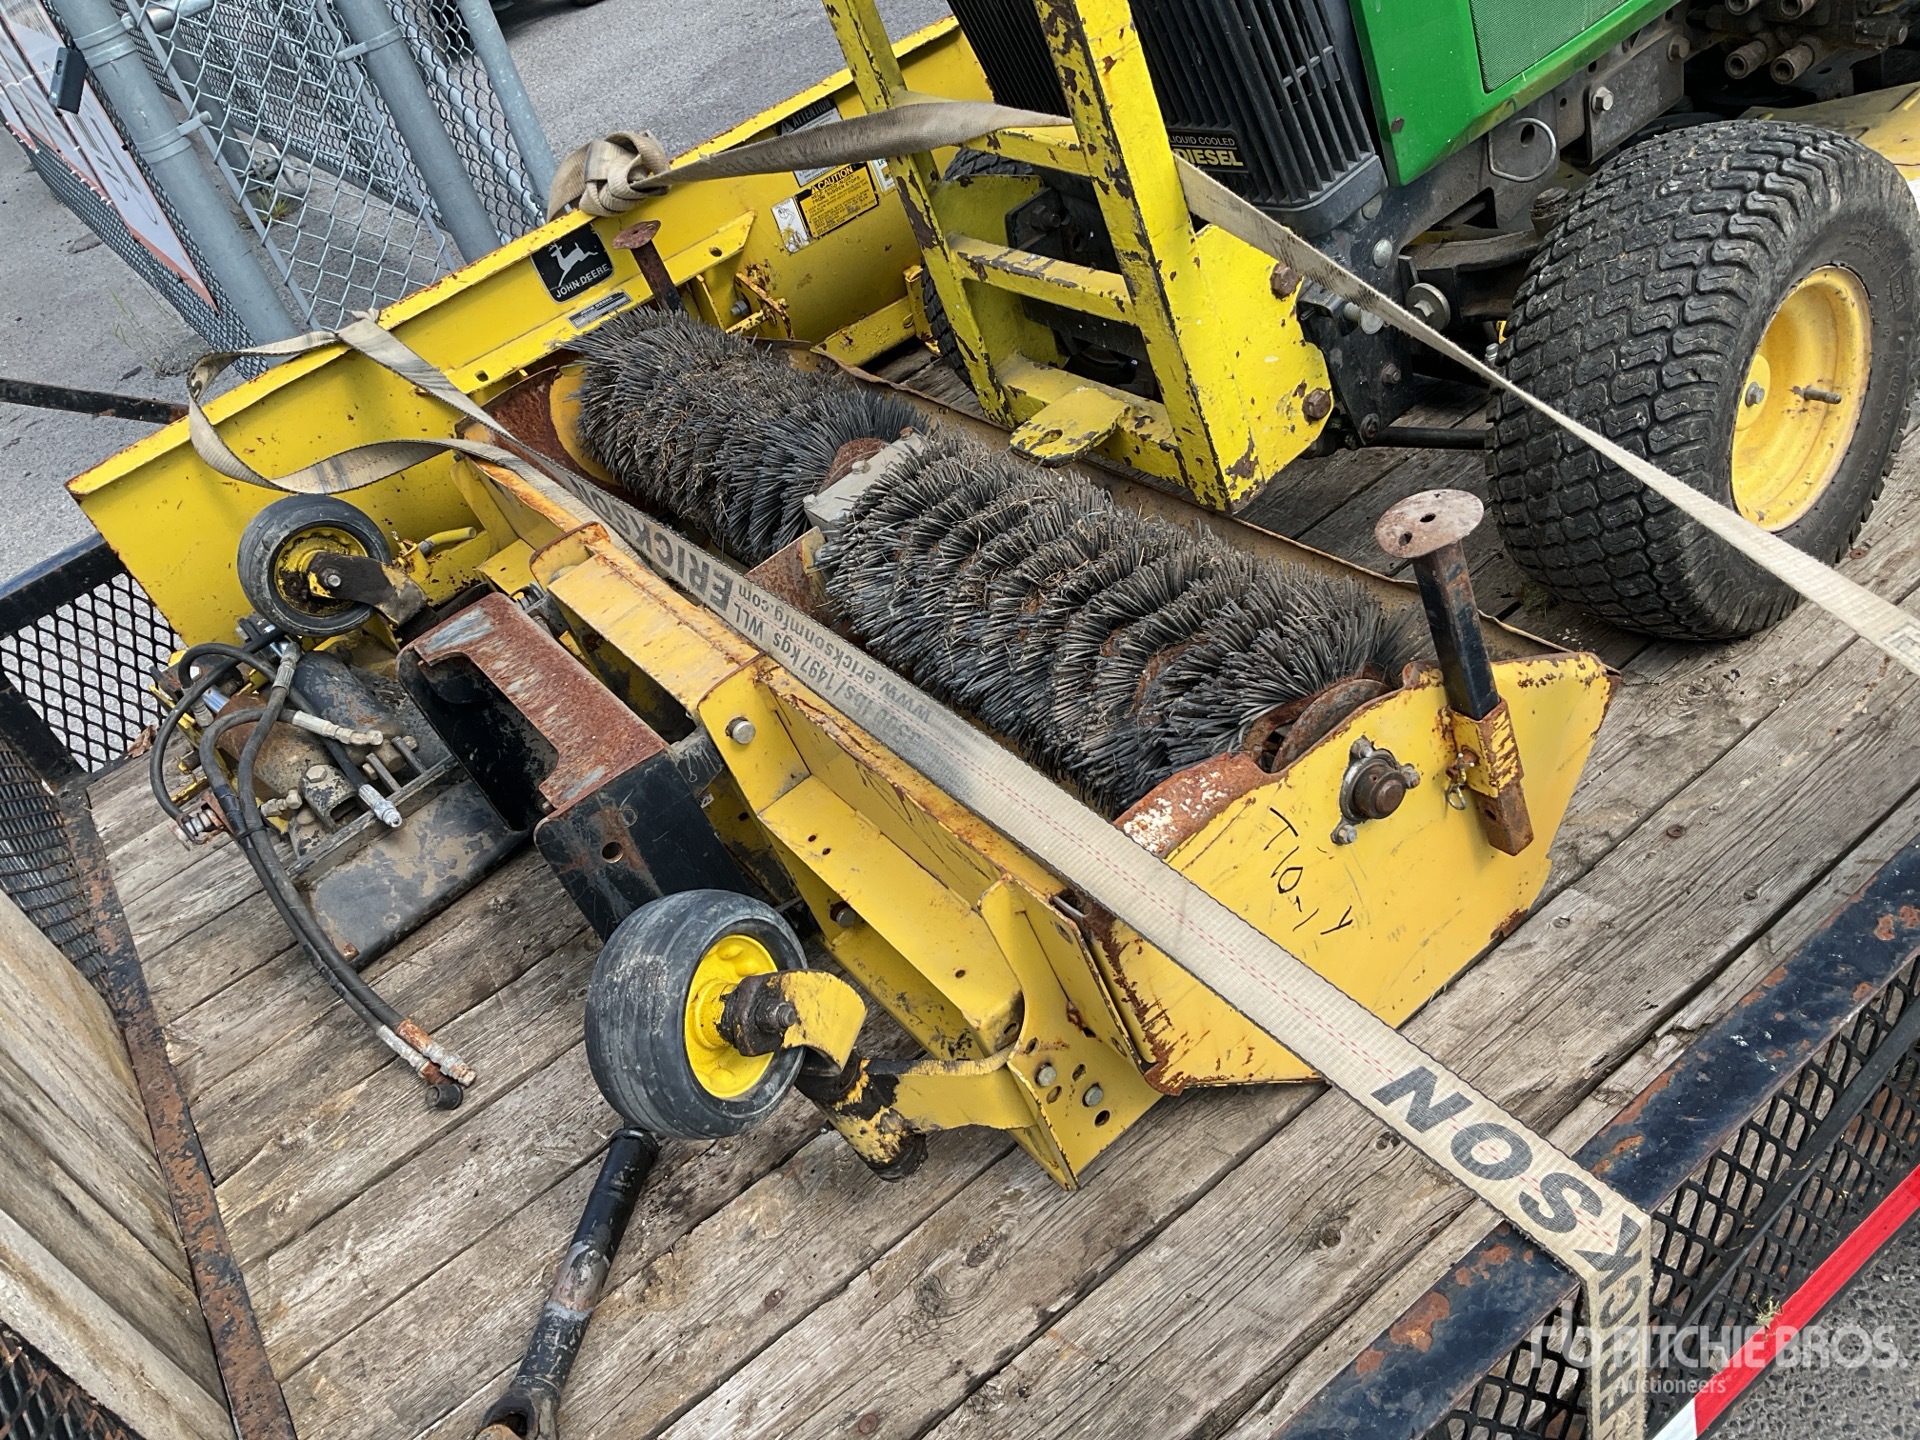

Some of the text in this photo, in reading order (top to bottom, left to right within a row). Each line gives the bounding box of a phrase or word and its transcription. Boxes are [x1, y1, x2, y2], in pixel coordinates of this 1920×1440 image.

[792, 97, 833, 128] ATTENTION
[1168, 135, 1235, 146] LIQUID COOLED
[1173, 148, 1244, 167] DIESEL
[816, 165, 853, 190] CAUTION
[556, 263, 610, 298] JOHN DEERE
[567, 473, 734, 612] ERICKSON
[733, 601, 764, 637] WLL
[738, 584, 930, 723] www.ericksonmfg.com
[773, 634, 802, 667] kgs
[1371, 1066, 1642, 1425] ERICKSON
